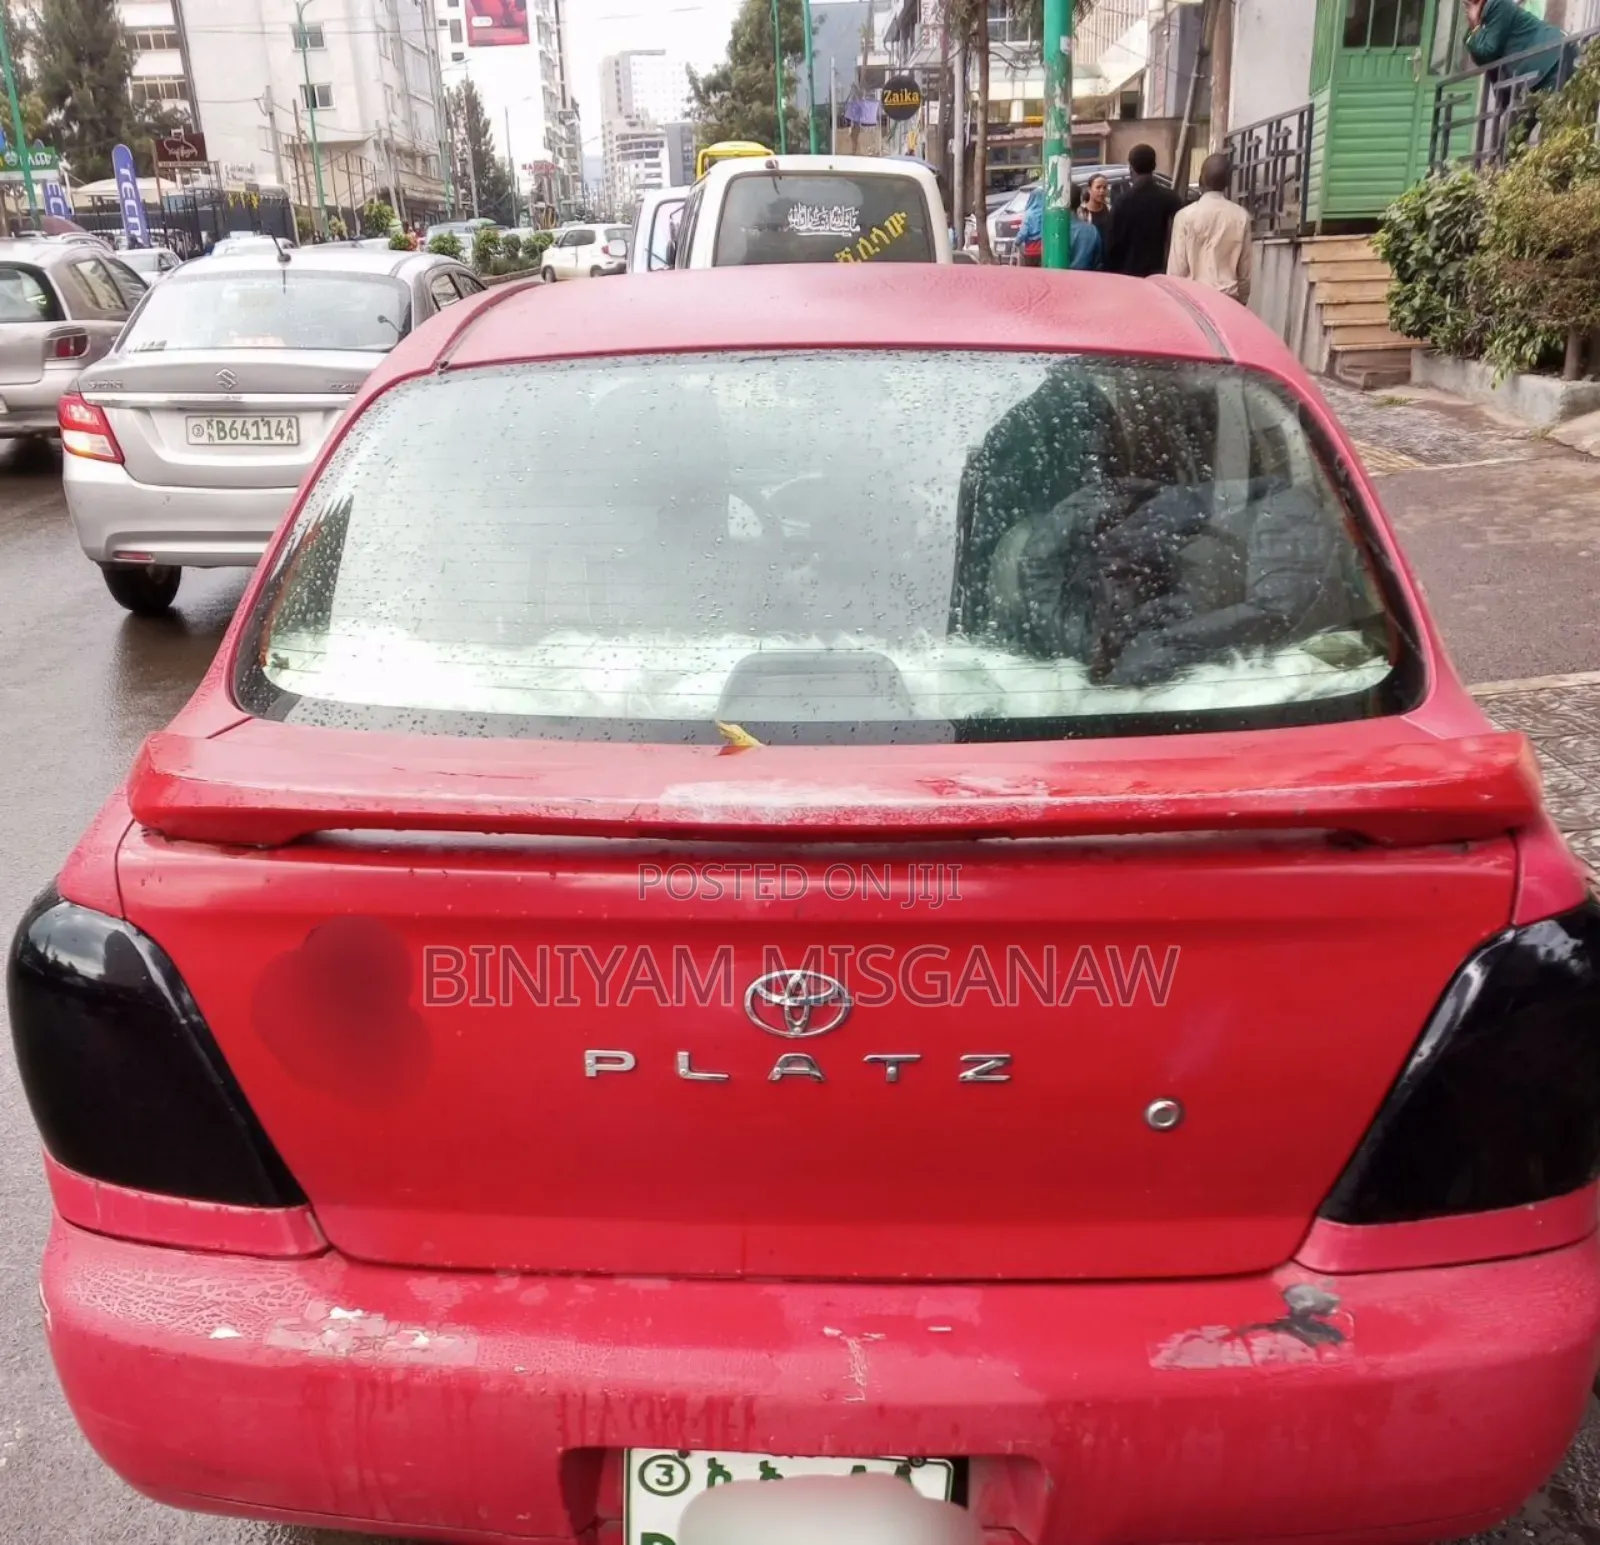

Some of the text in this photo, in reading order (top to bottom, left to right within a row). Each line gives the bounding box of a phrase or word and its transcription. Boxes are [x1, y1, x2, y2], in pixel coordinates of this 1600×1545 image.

[884, 88, 920, 103] Zaika
[119, 164, 144, 245] TECN
[216, 419, 285, 441] B64114
[584, 1049, 1012, 1083] PLATZ
